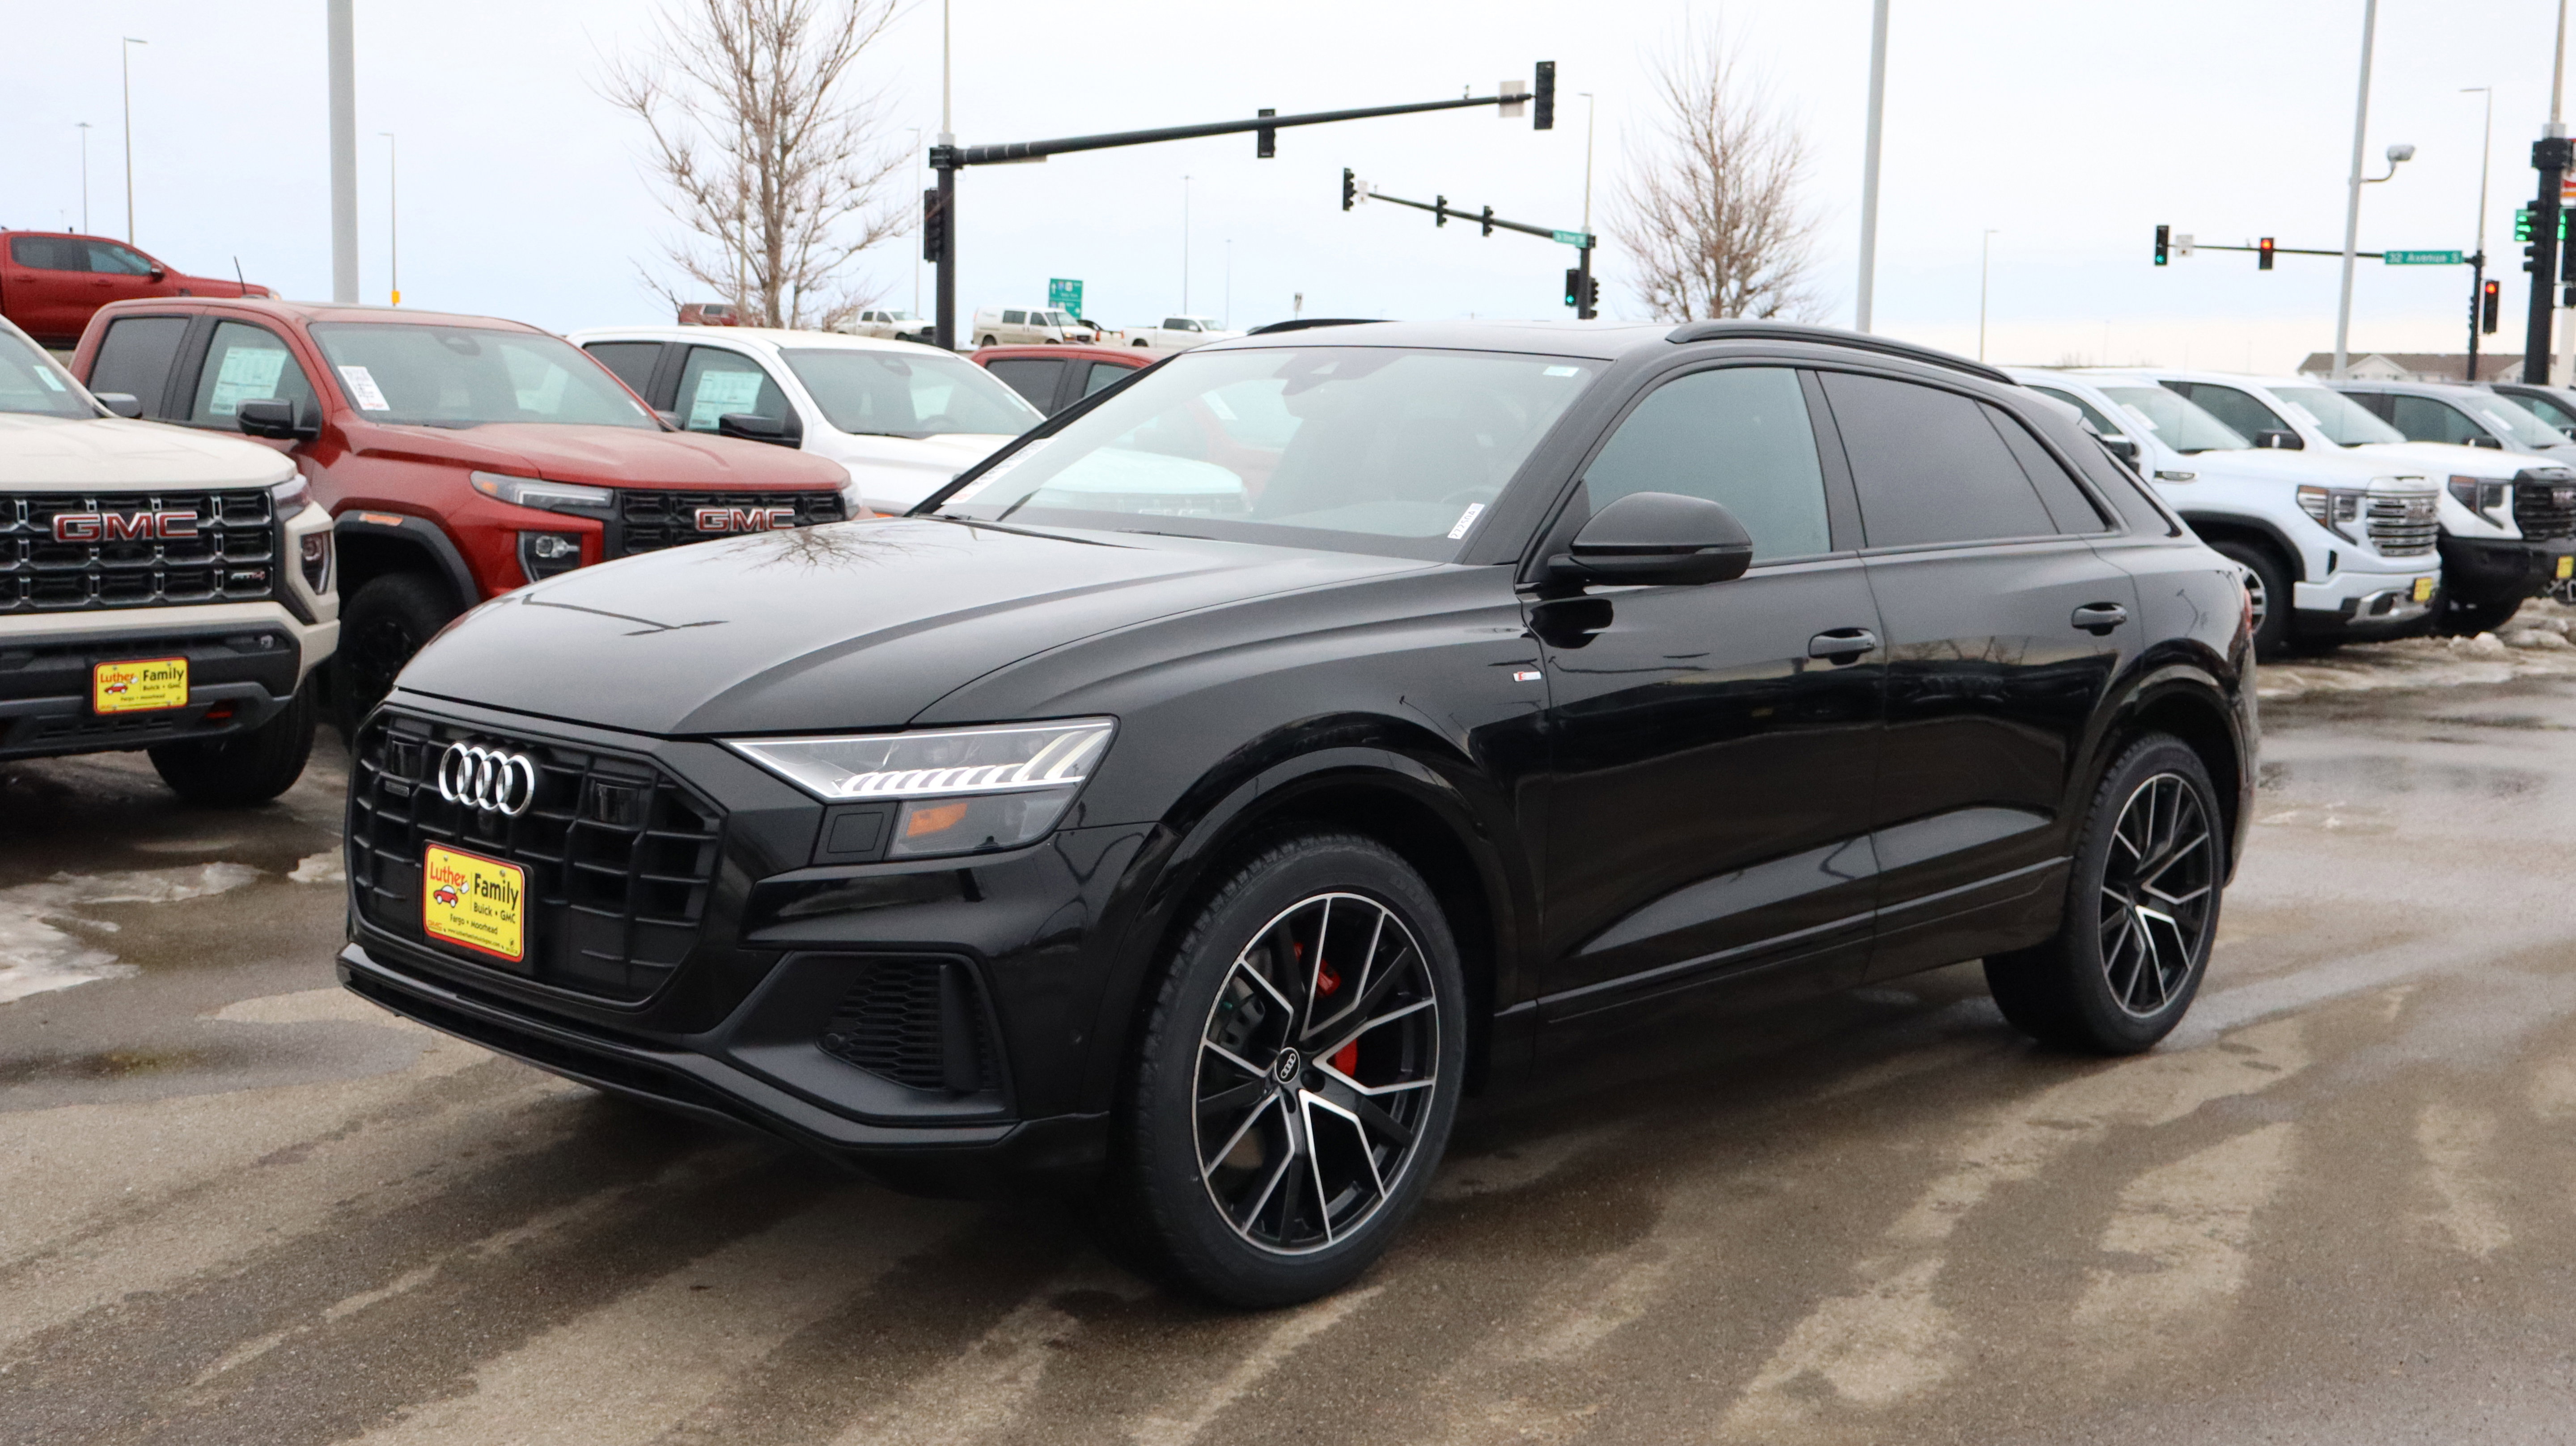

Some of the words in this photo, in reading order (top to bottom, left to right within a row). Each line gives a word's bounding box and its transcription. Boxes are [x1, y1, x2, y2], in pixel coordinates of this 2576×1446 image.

[53, 511, 198, 543] GMC
[695, 508, 795, 532] GMC
[100, 672, 134, 683] Luther
[143, 667, 184, 681] Family
[430, 861, 466, 886] Luther
[475, 873, 519, 911] Family
[450, 914, 465, 926] Fargo
[471, 921, 498, 935] Moorhead
[474, 902, 492, 916] Buick
[500, 911, 516, 924] GMC
